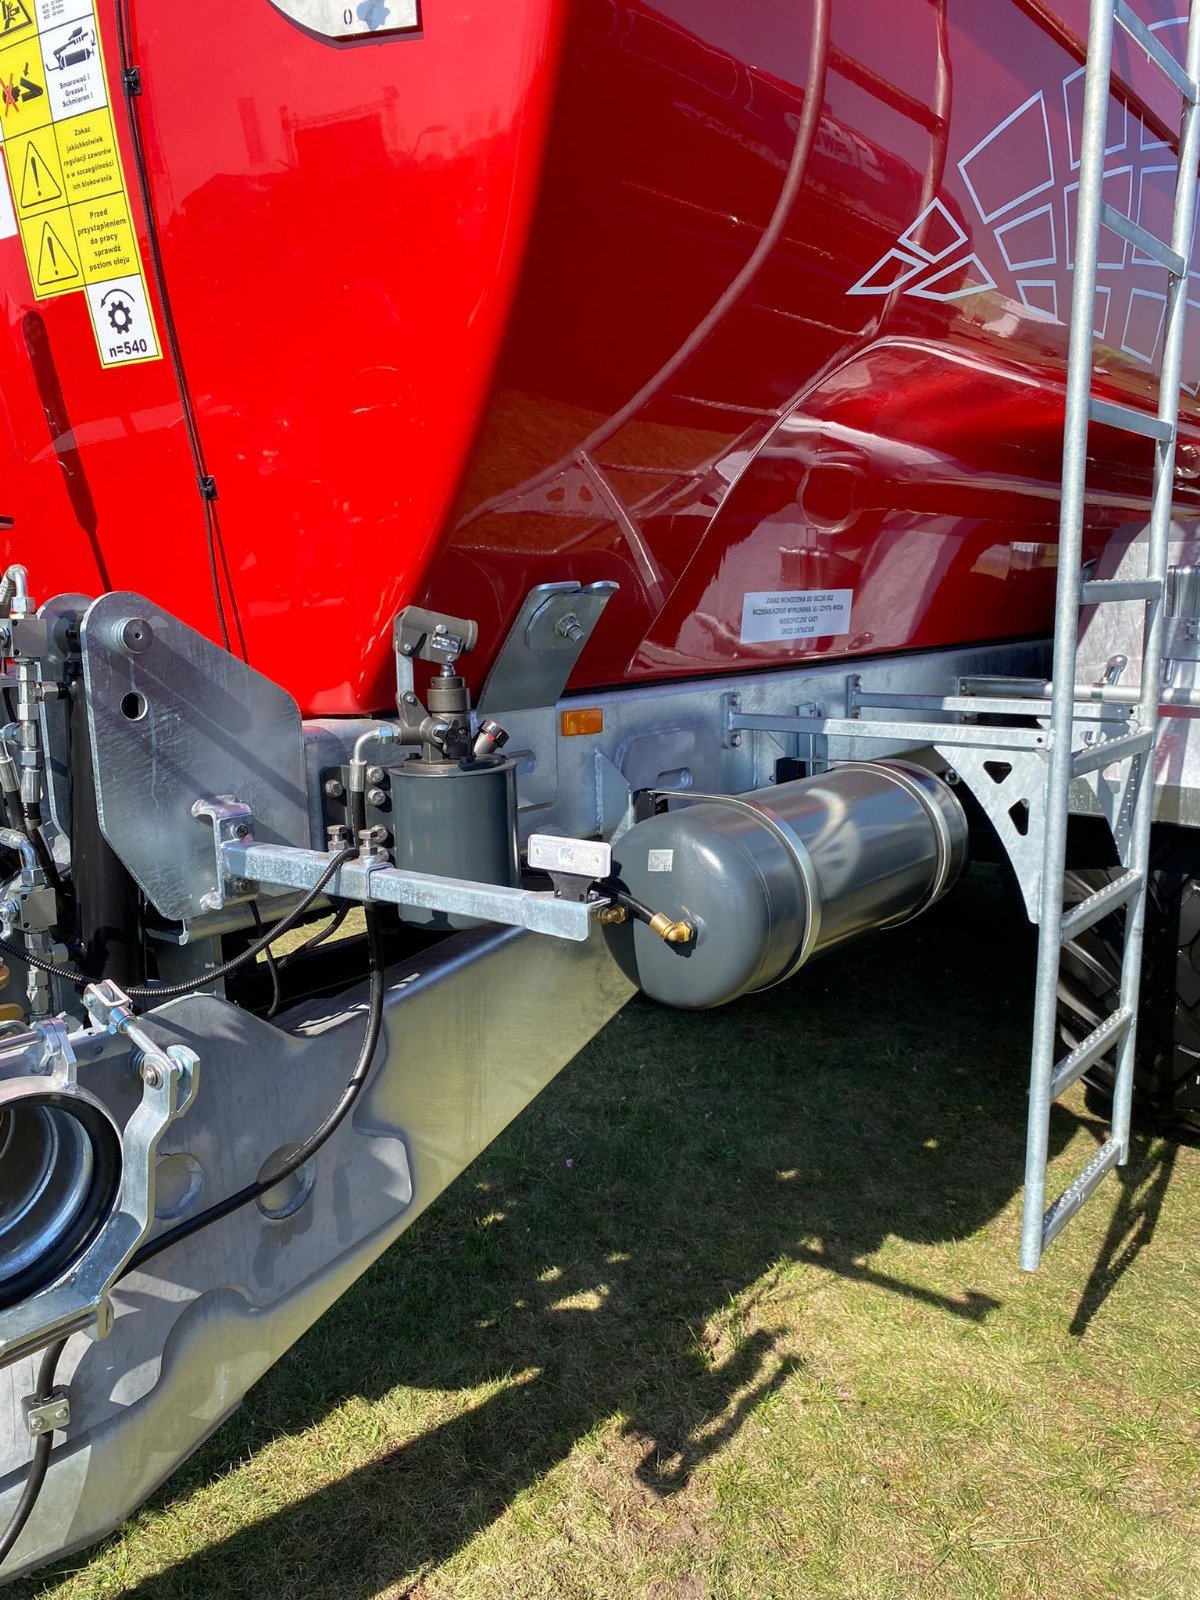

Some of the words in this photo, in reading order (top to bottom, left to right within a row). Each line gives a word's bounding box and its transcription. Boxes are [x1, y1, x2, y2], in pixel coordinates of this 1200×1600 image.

[59, 75, 87, 89] Smarować
[65, 87, 84, 97] Grease
[62, 94, 90, 108] Schmieren
[74, 127, 91, 136] Zakaz
[66, 136, 103, 153] jakichkolwiek
[63, 154, 87, 167] regulacji
[87, 148, 112, 159] zaworów
[77, 160, 114, 175] szczególności
[72, 182, 81, 190] ich
[81, 174, 112, 187] blokowania
[89, 208, 108, 219] Przed
[90, 237, 99, 245] do
[99, 233, 118, 244] pracy
[89, 260, 113, 272] poziom
[113, 255, 130, 266] oleju
[109, 339, 147, 357] n=540
